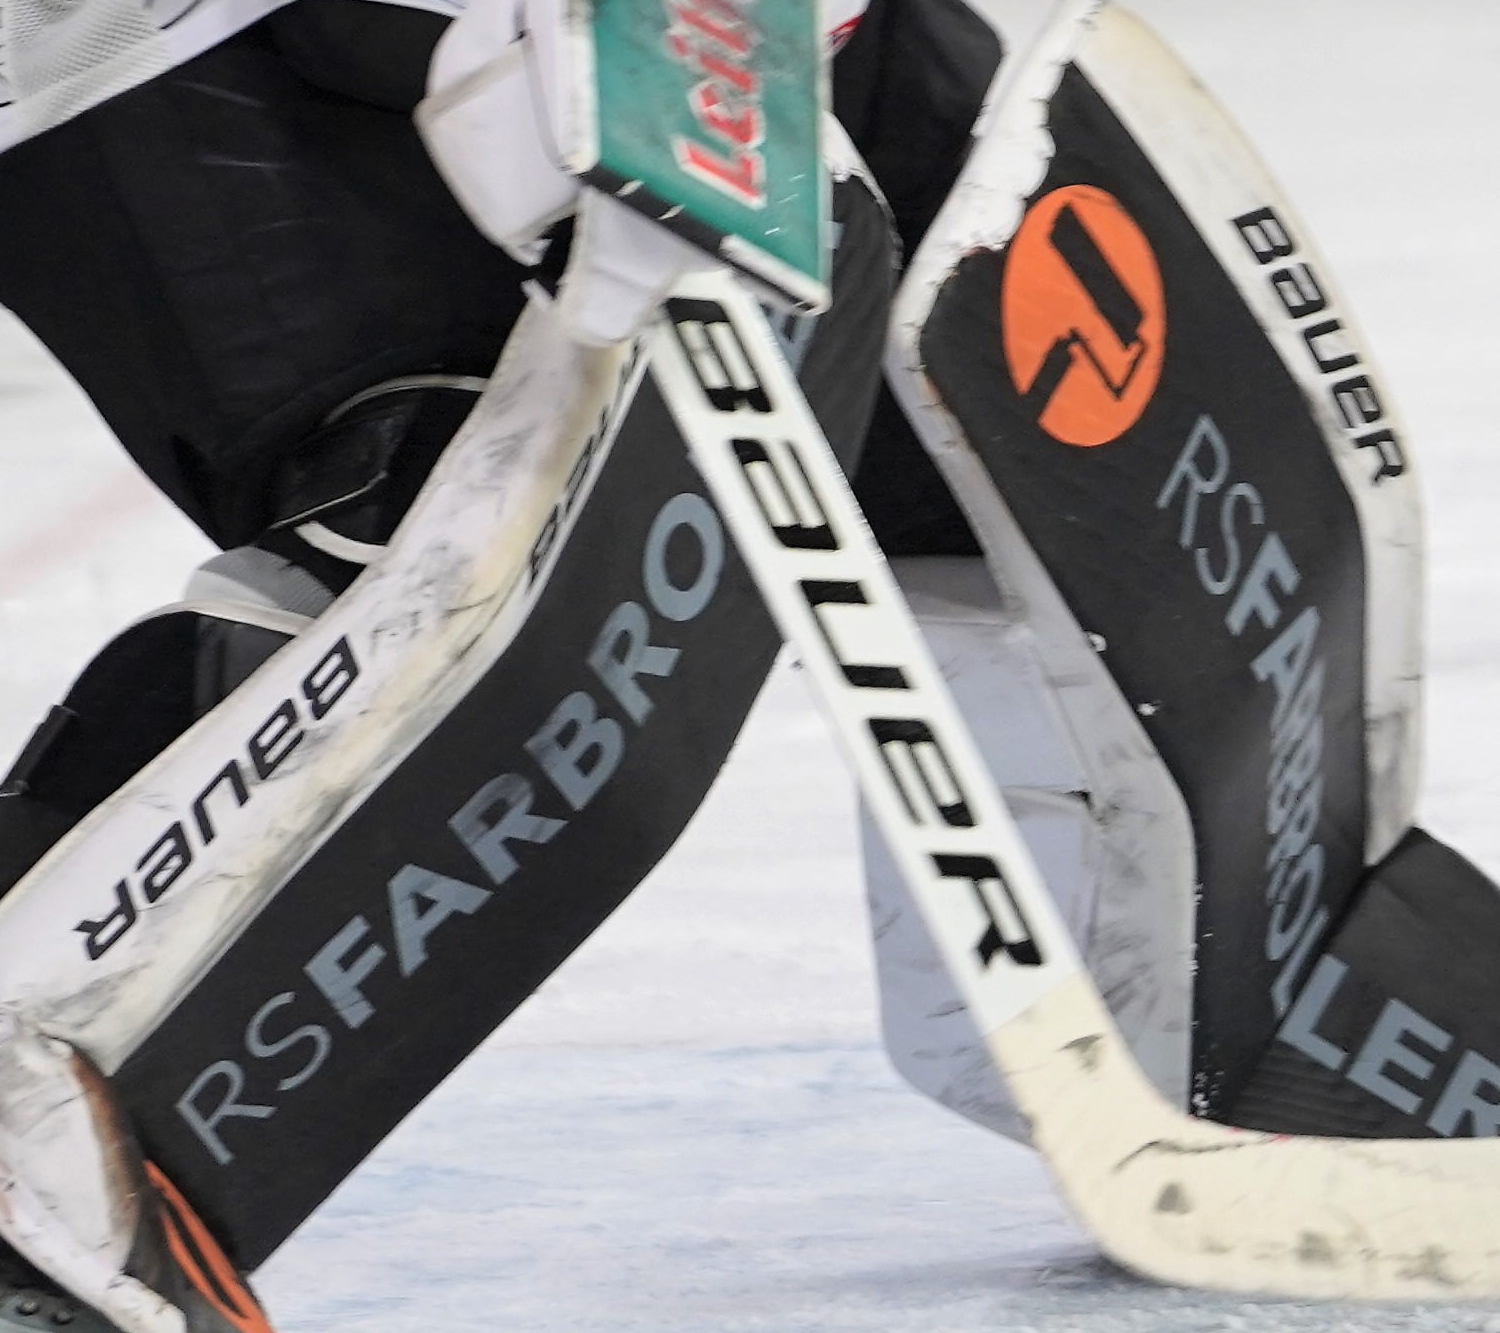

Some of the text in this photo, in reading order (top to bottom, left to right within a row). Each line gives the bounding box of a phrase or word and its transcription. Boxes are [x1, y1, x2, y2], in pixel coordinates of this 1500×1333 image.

[1230, 205, 1407, 487] BAUER
[73, 631, 362, 963] BAUER
[666, 294, 1050, 976] BAUER
